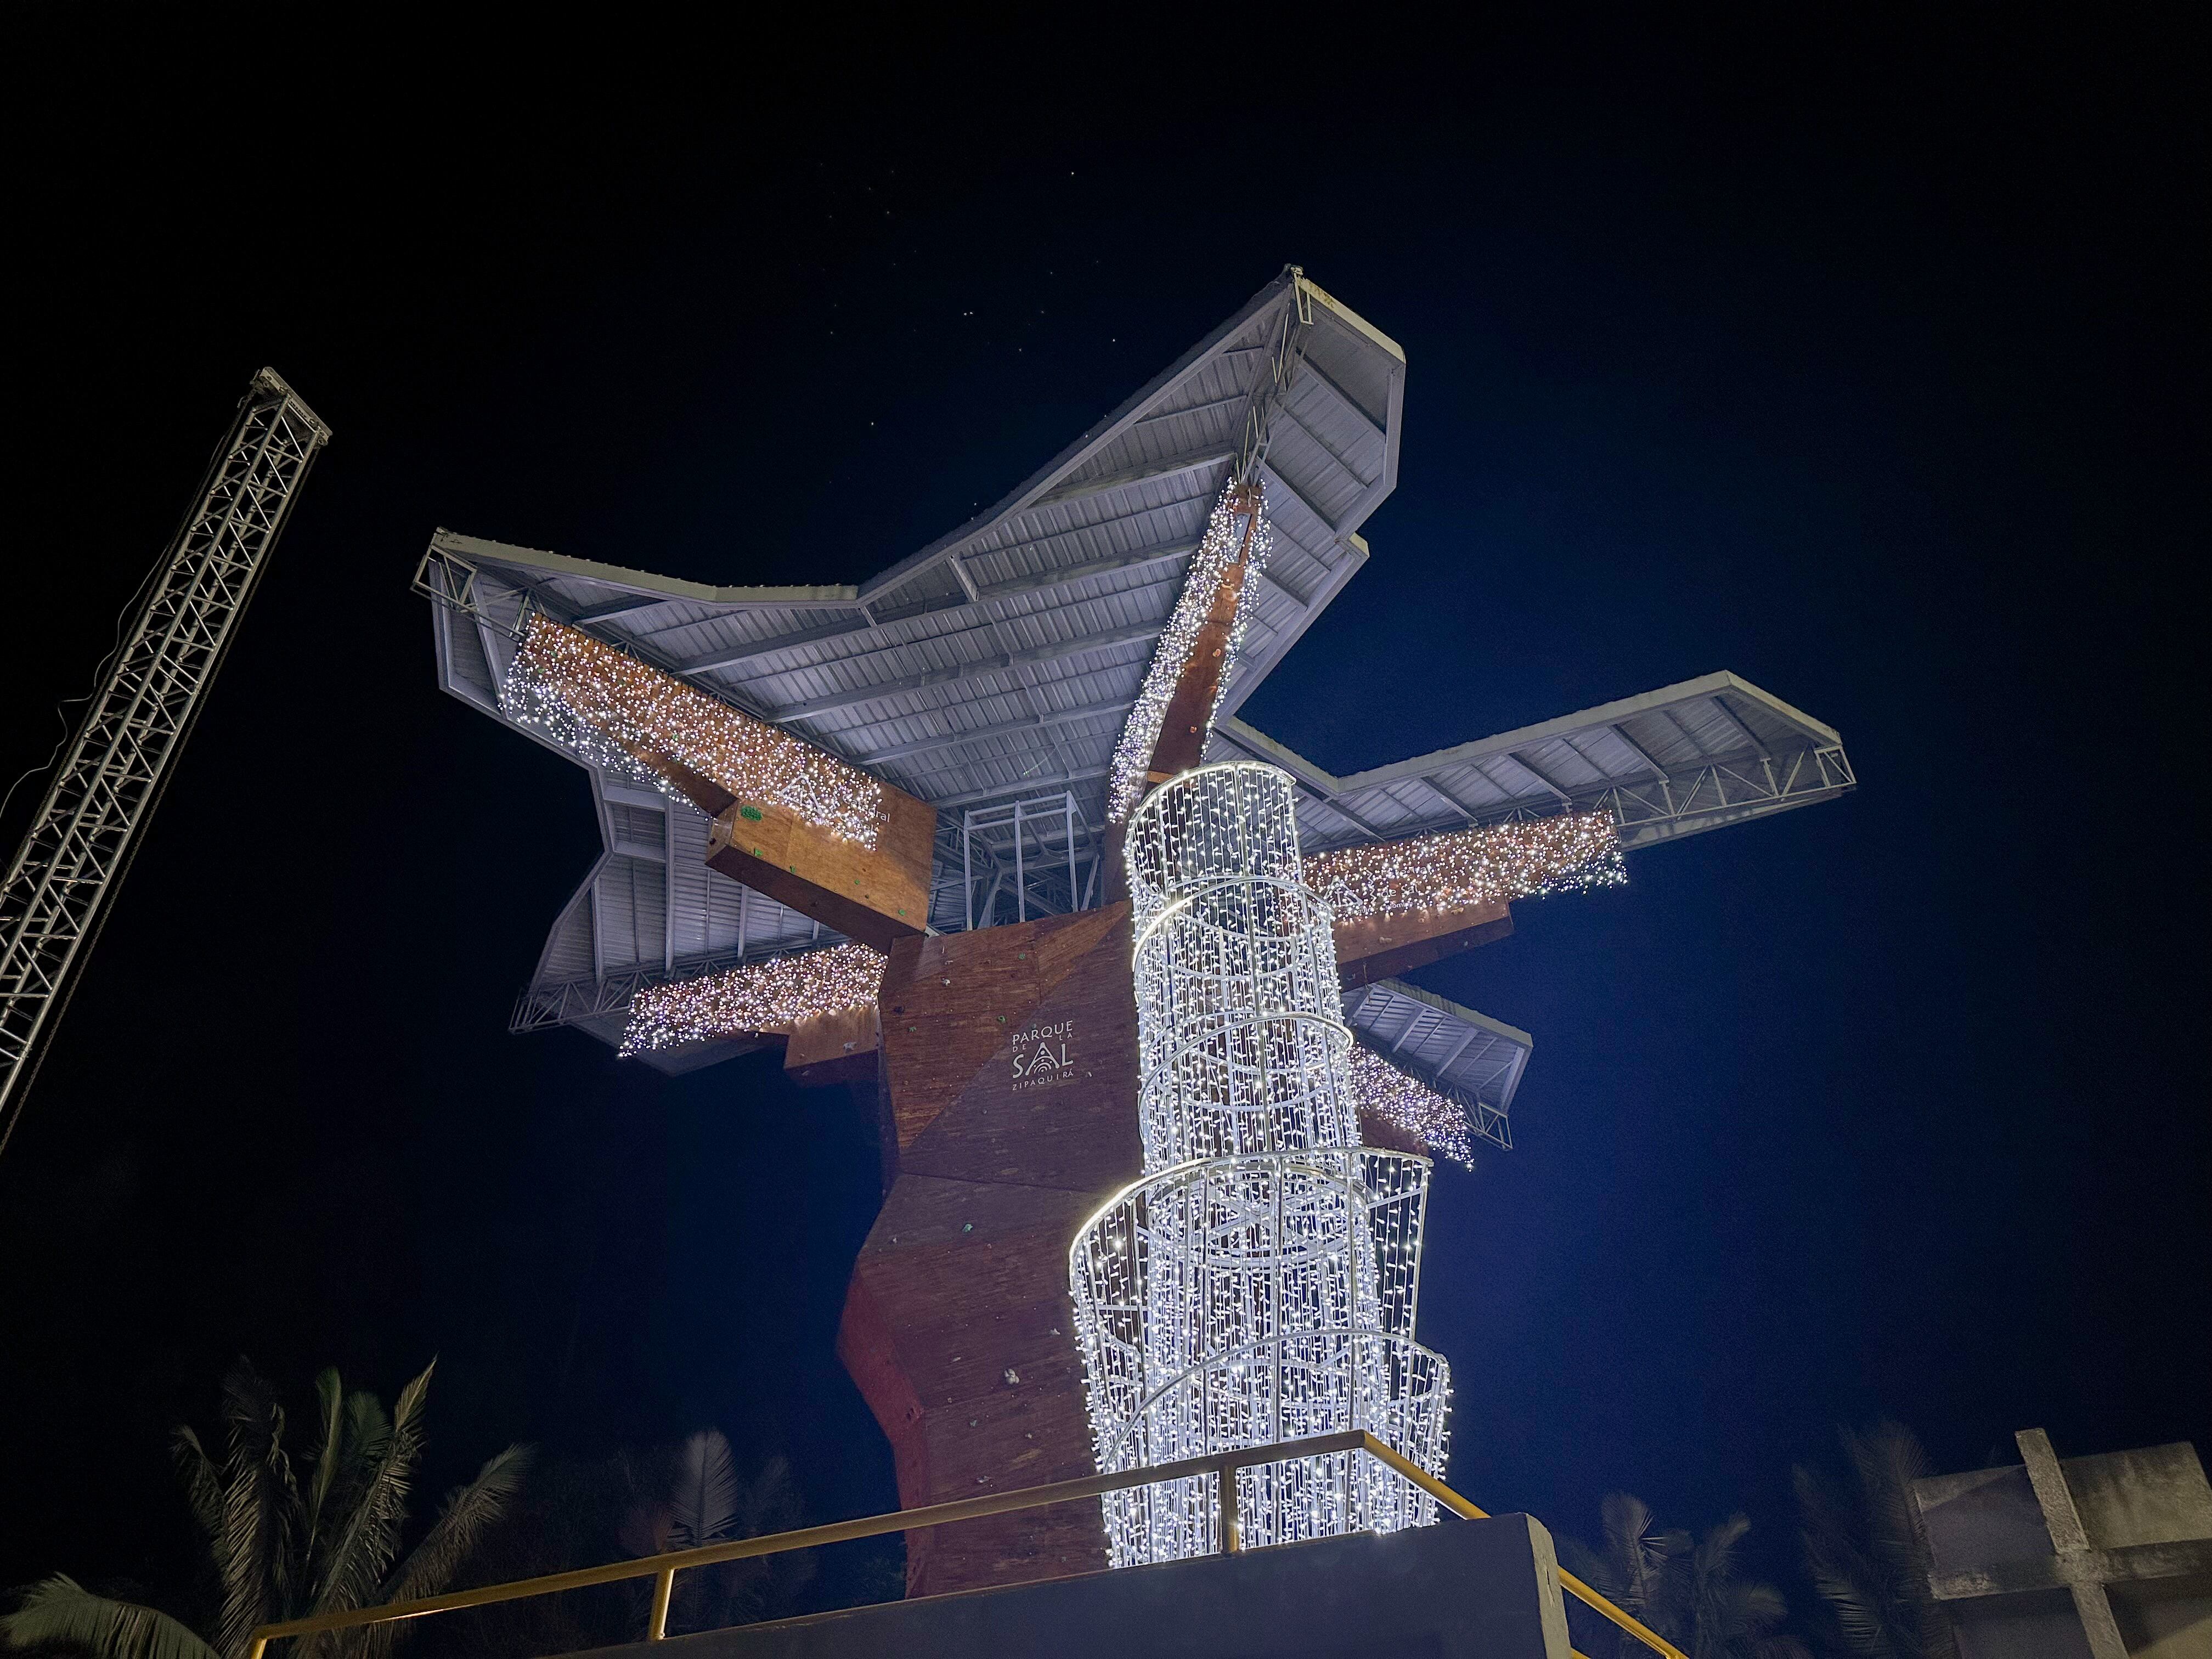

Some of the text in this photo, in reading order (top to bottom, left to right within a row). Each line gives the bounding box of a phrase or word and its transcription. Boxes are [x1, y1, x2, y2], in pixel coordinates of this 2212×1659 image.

[1012, 1020, 1073, 1045] PARQUE
[1012, 1032, 1073, 1053] DE LA
[1012, 1042, 1074, 1079] SAL
[1012, 1068, 1074, 1091] ZIPAQUIRÁ
